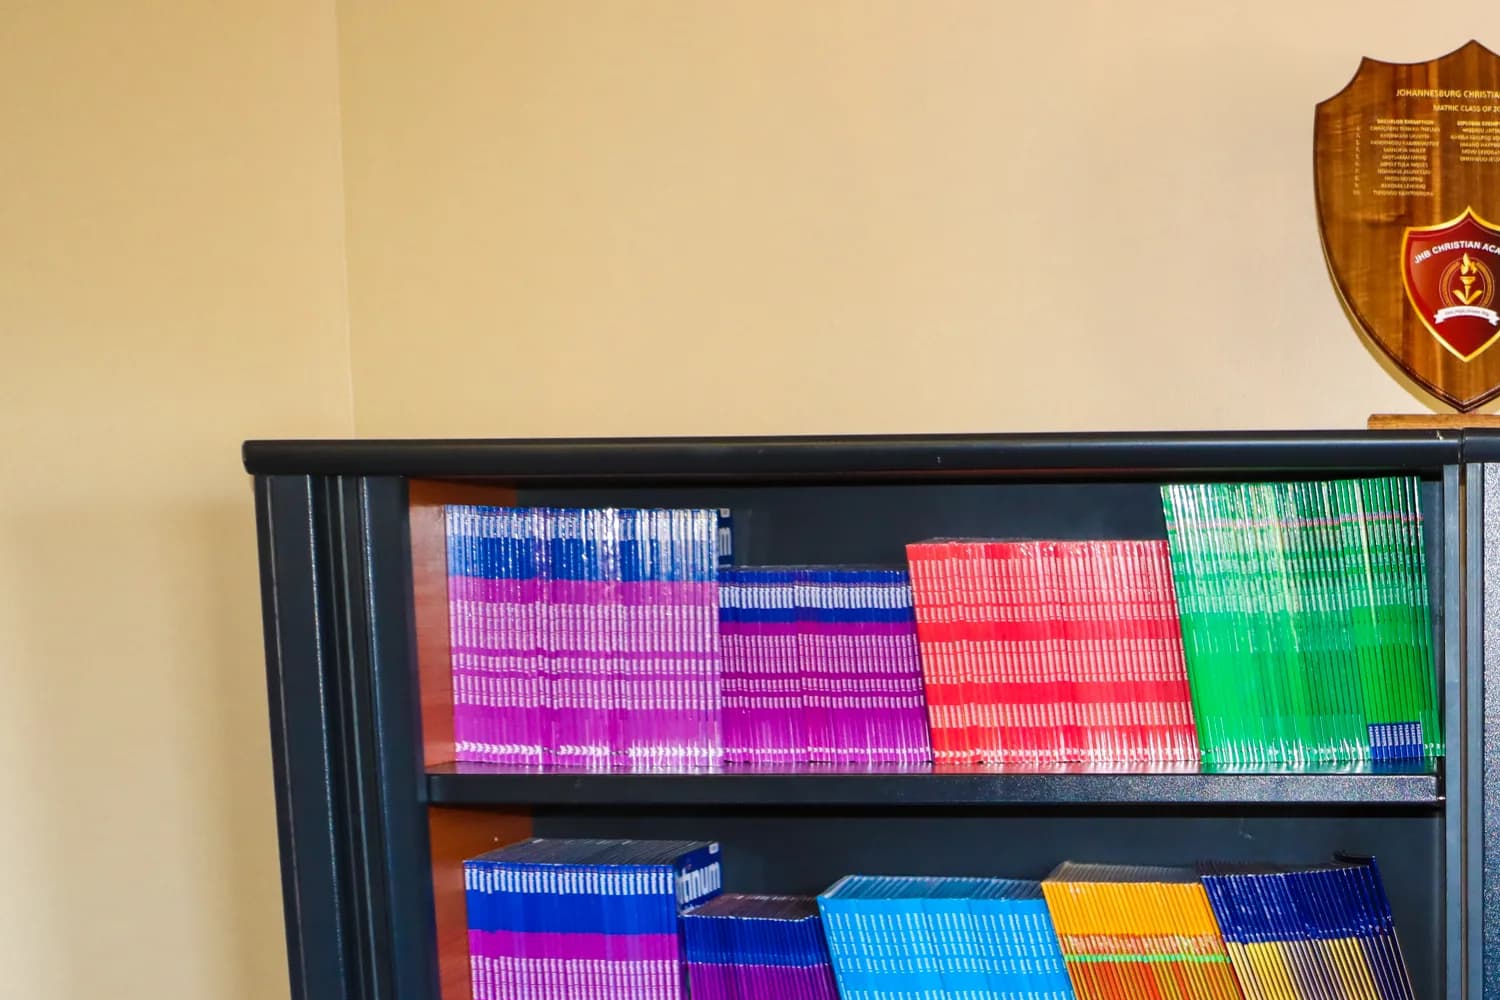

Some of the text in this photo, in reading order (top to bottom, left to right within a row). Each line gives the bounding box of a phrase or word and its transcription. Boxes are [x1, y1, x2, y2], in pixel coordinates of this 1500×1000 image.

[1396, 89, 1462, 98] JOHANNESBURG
[1460, 105, 1481, 113] CLASS
[1414, 248, 1432, 264] JHB
[1431, 240, 1481, 255] CHRISTIAN
